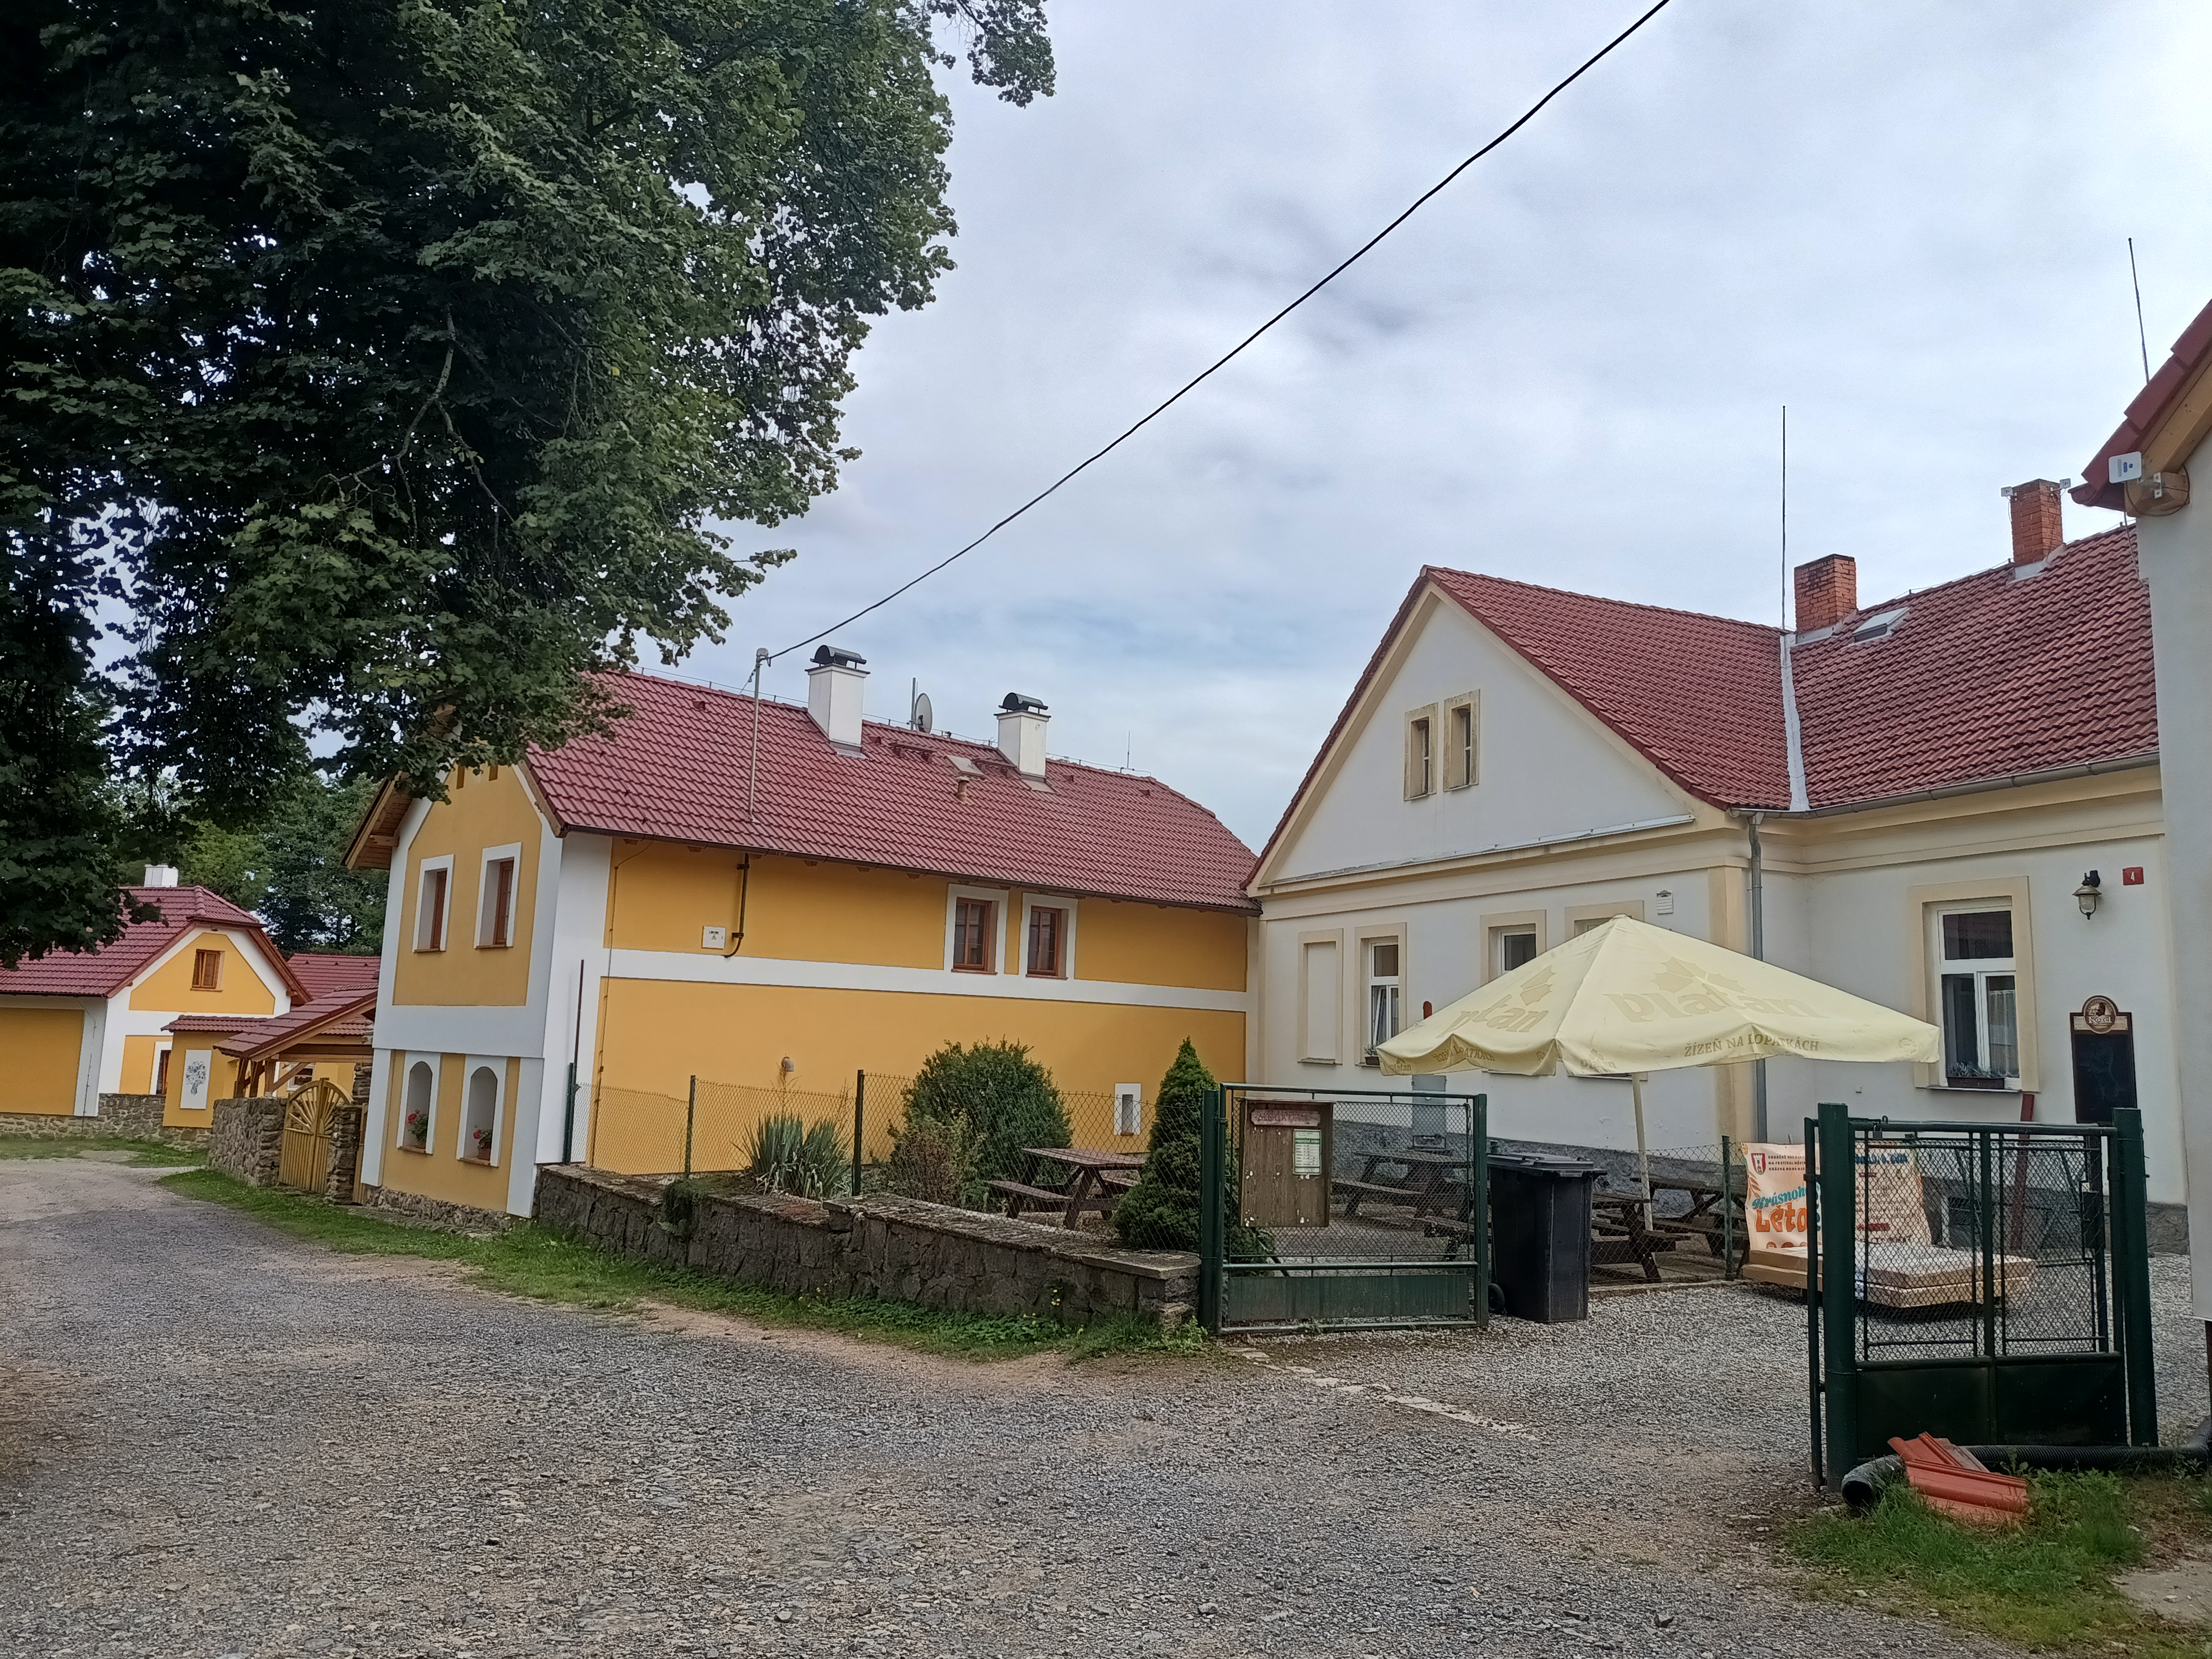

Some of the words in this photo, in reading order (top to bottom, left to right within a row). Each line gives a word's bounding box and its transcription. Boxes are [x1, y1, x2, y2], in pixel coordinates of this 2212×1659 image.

[2130, 871, 2135, 881] 4
[1601, 983, 1830, 1023] platan
[2088, 1016, 2112, 1024] Kozel
[1684, 1038, 1723, 1057] ŽÍZEŇ
[1726, 1036, 1744, 1049] NA
[1747, 1034, 1820, 1052] LOPATKÁCH
[1752, 1186, 1806, 1209] Krásnoh
